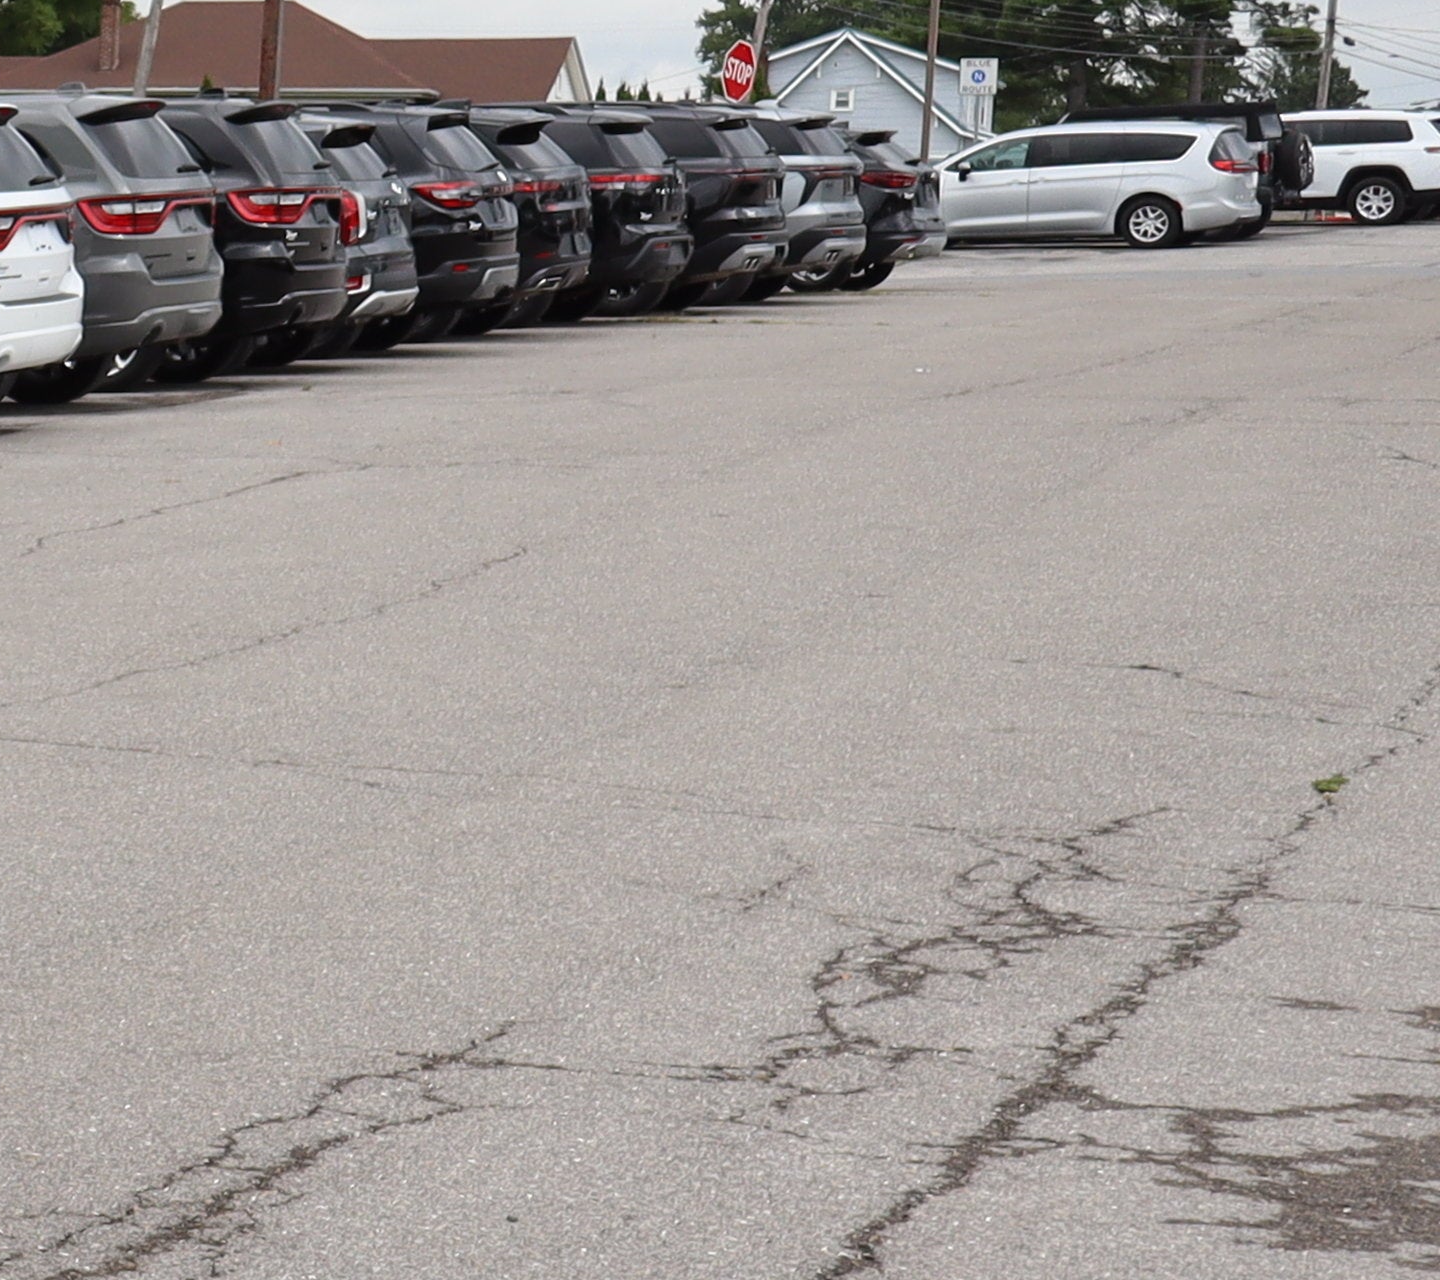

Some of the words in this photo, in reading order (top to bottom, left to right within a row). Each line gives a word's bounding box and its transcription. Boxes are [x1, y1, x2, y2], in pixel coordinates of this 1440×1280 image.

[966, 59, 992, 68] BLUE
[725, 57, 753, 86] STOP
[962, 85, 994, 94] ROUTE
